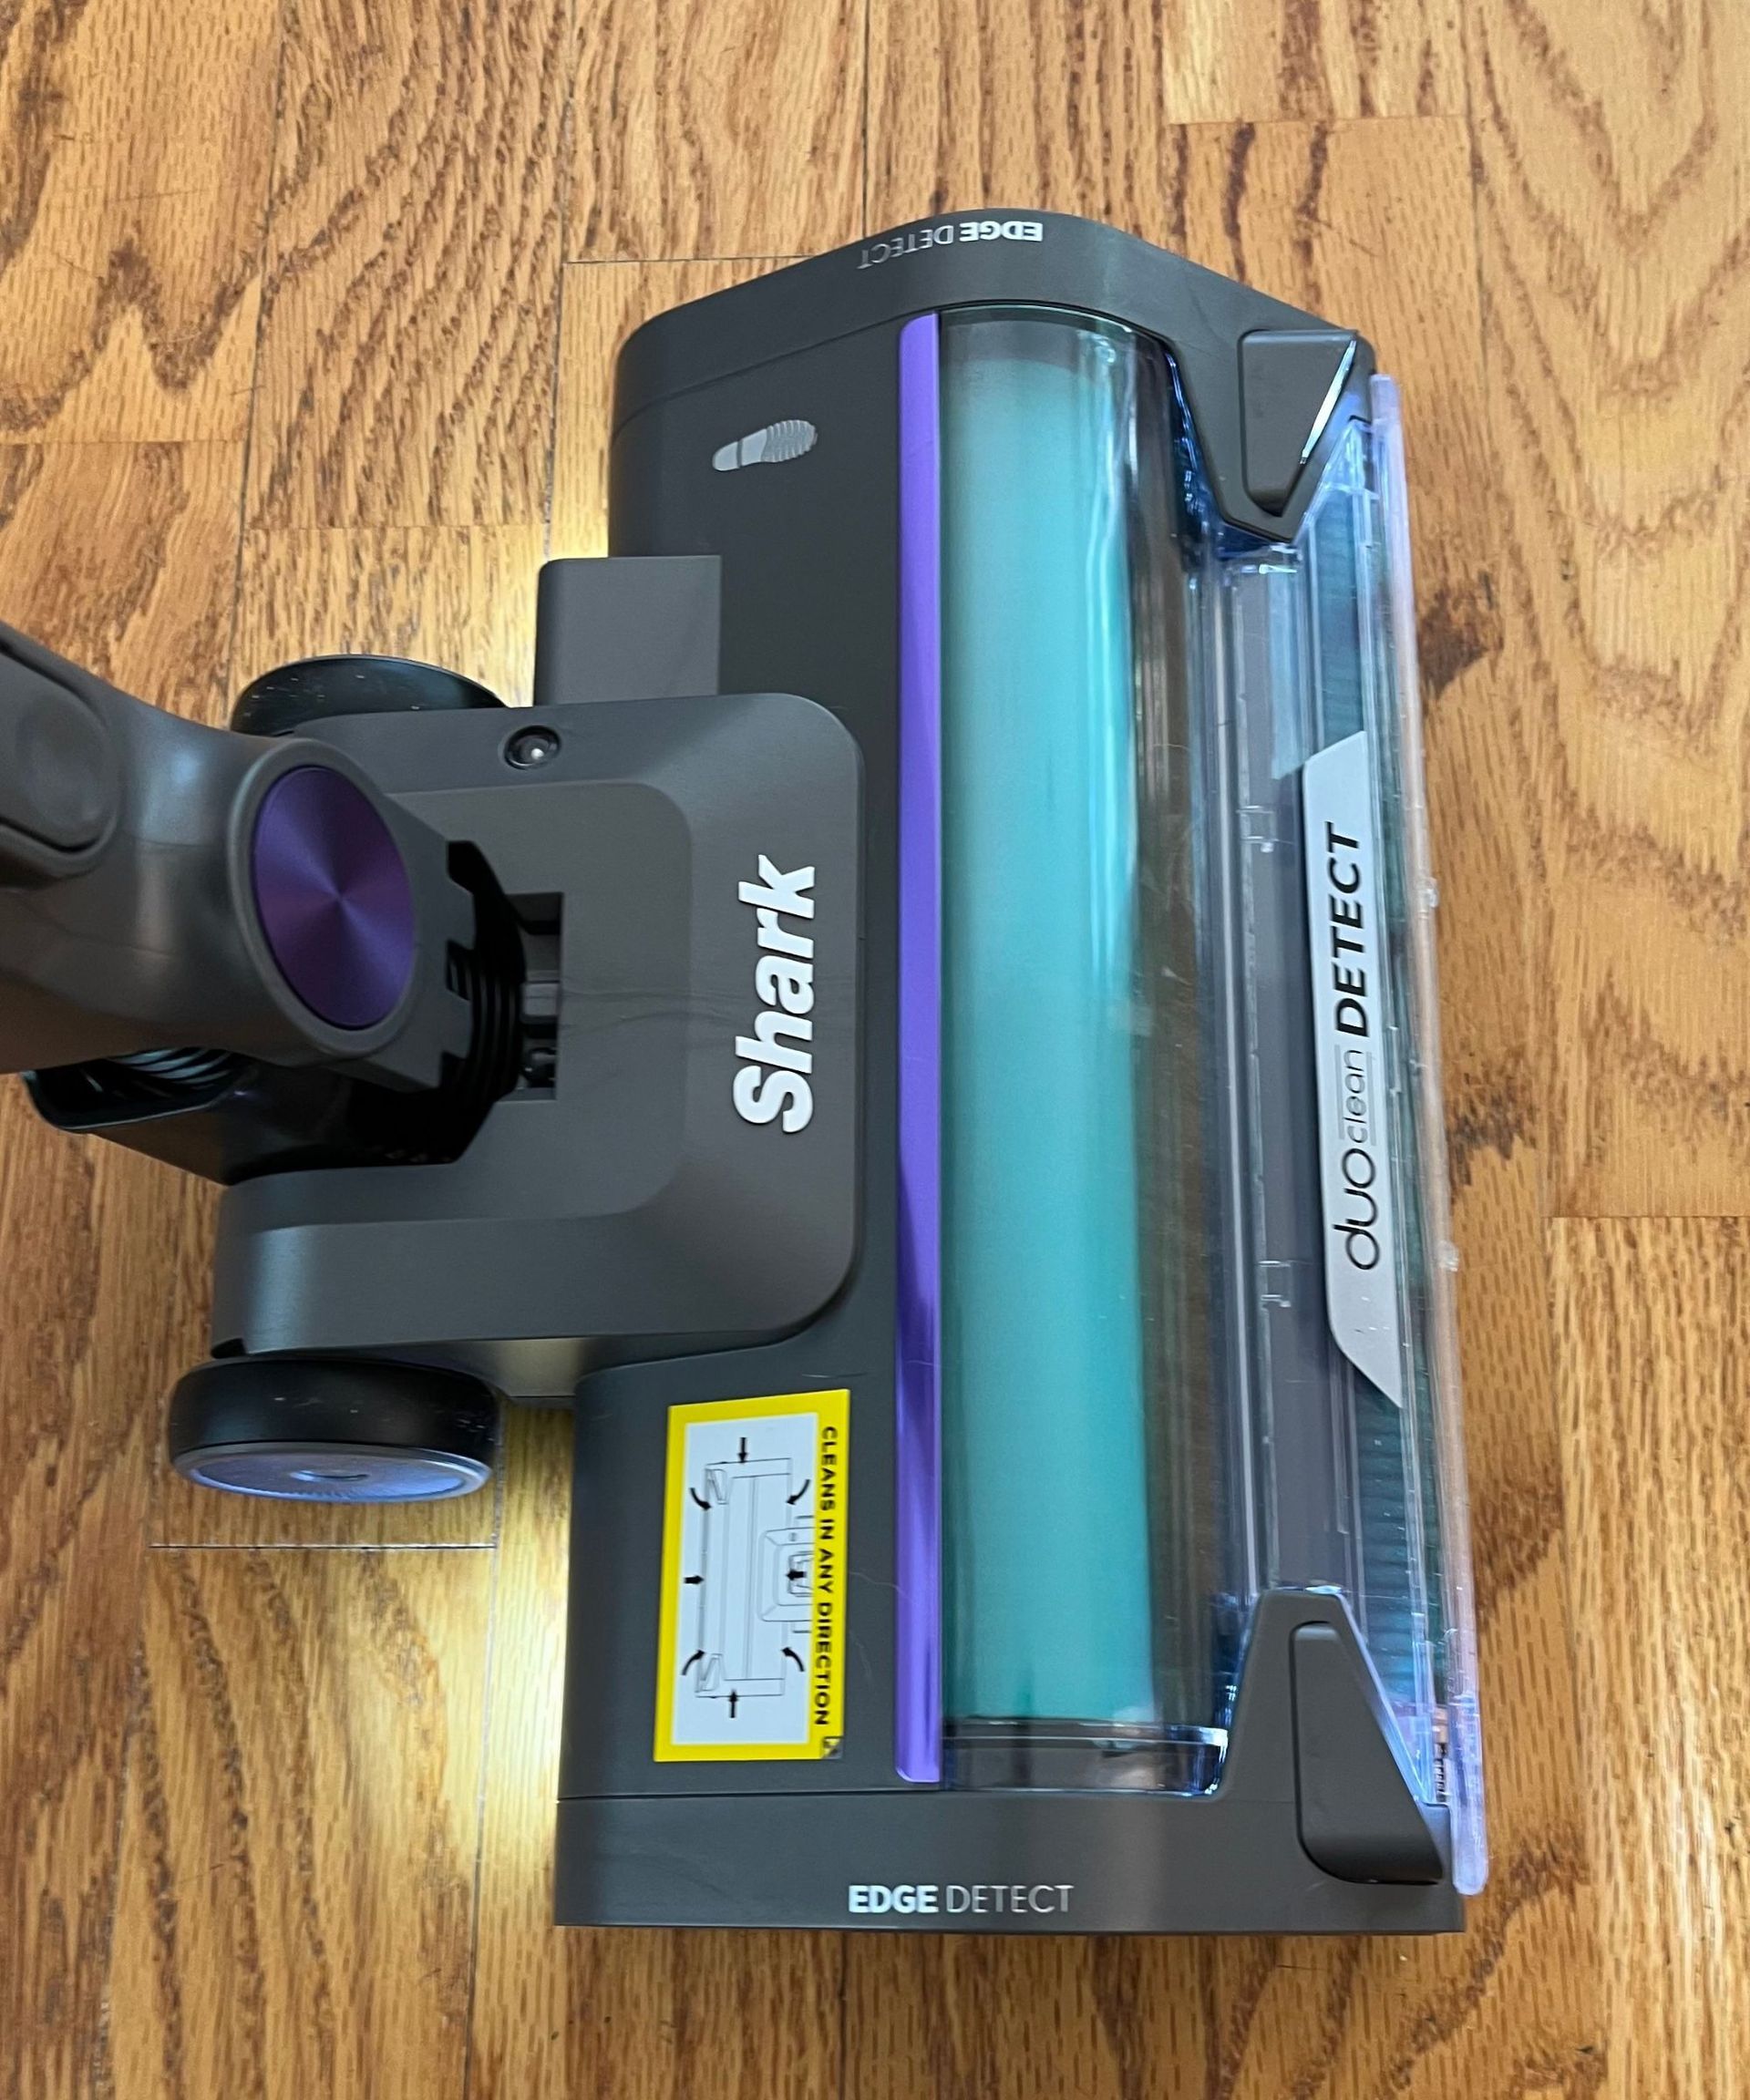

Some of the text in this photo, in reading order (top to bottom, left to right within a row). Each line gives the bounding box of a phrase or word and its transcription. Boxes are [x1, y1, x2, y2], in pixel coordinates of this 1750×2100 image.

[857, 221, 1044, 270] EDGE DETECT
[733, 853, 816, 1134] Shark
[1324, 821, 1369, 1038] DETECT
[815, 1426, 838, 1725] CLEANS IN ANY DIRECTION
[849, 1884, 1075, 1914] EDGE DETECT
